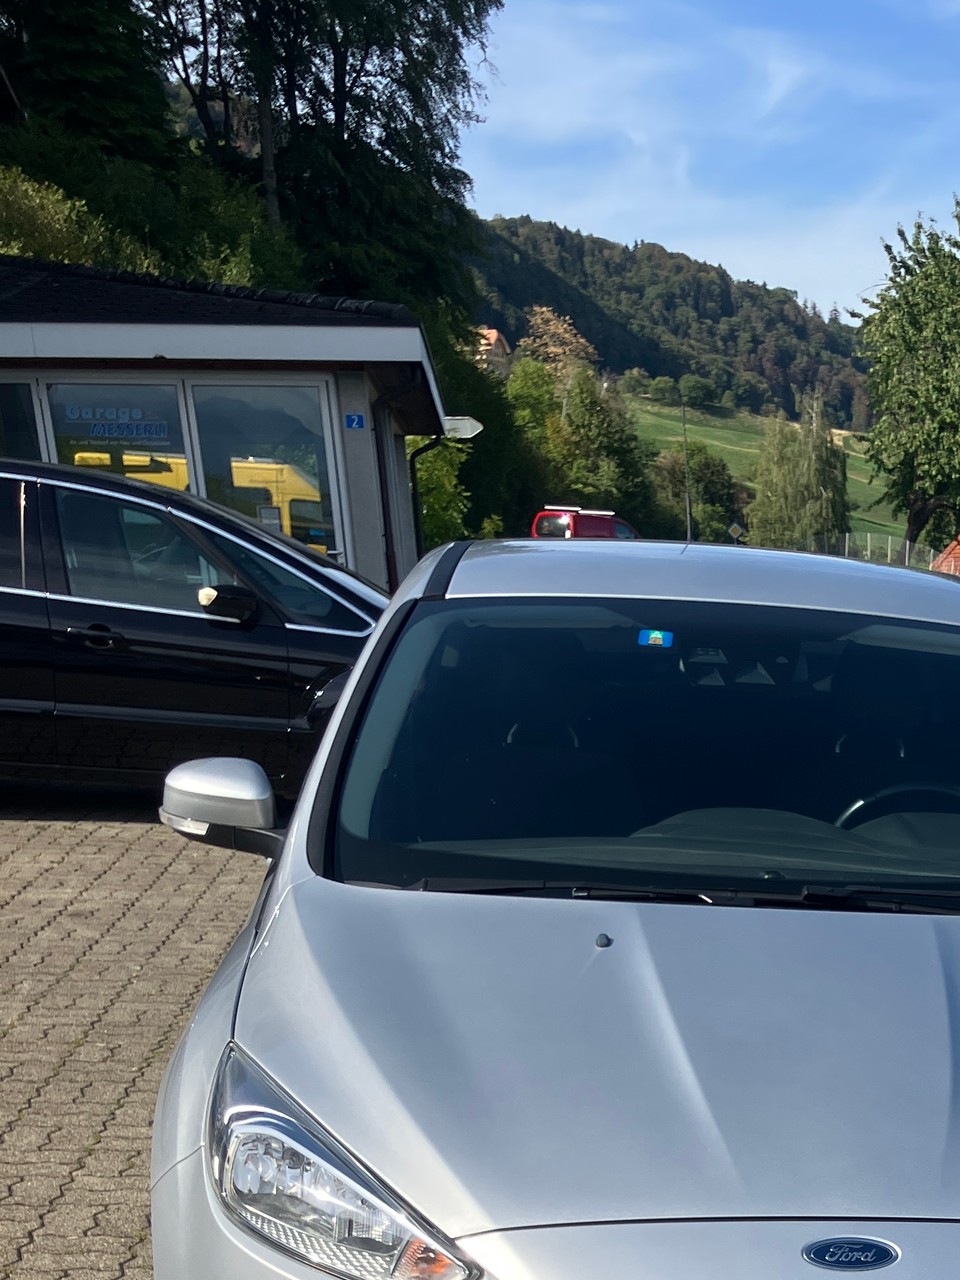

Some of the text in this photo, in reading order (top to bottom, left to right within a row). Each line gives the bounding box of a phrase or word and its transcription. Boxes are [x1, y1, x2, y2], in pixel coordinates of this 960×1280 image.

[64, 405, 142, 423] Garage
[351, 415, 359, 428] 2
[825, 1243, 877, 1262] Ford
